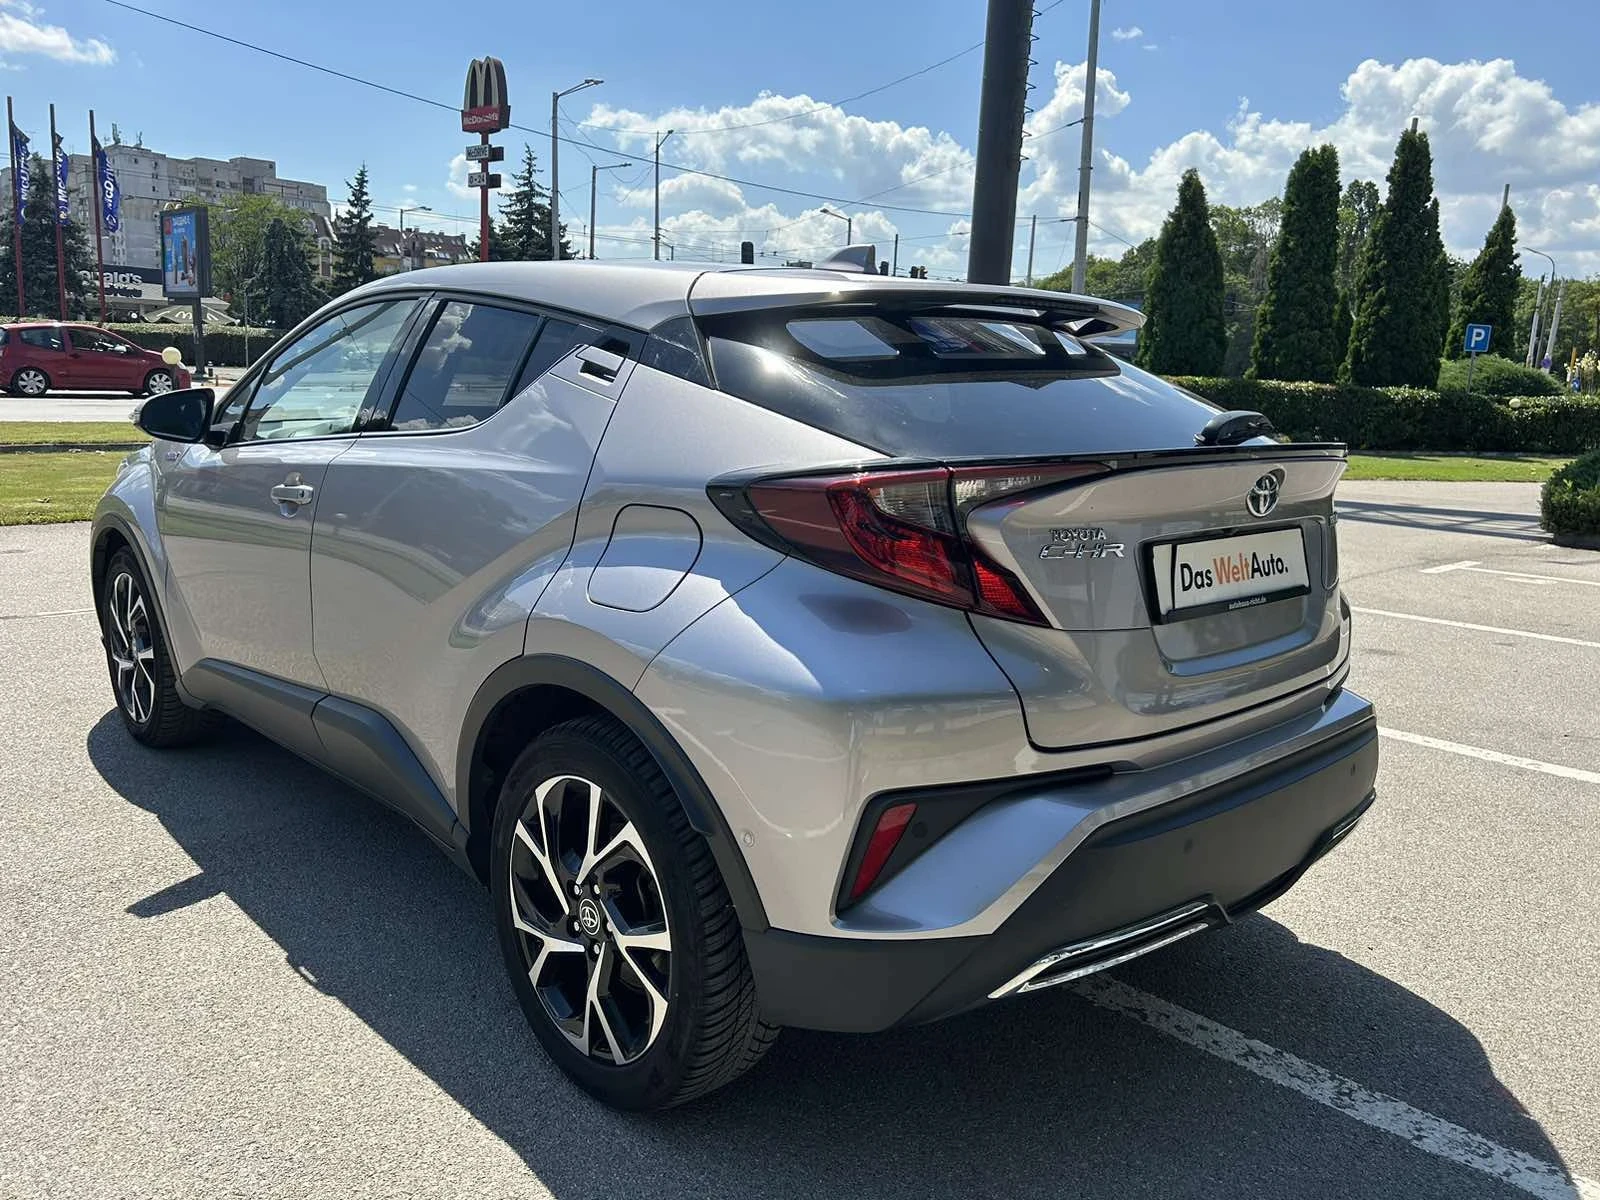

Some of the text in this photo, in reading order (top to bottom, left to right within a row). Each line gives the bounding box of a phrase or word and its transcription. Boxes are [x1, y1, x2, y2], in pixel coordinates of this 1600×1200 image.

[1471, 328, 1485, 347] P
[1049, 528, 1107, 541] TOYOTA
[1039, 543, 1125, 559] C-HR
